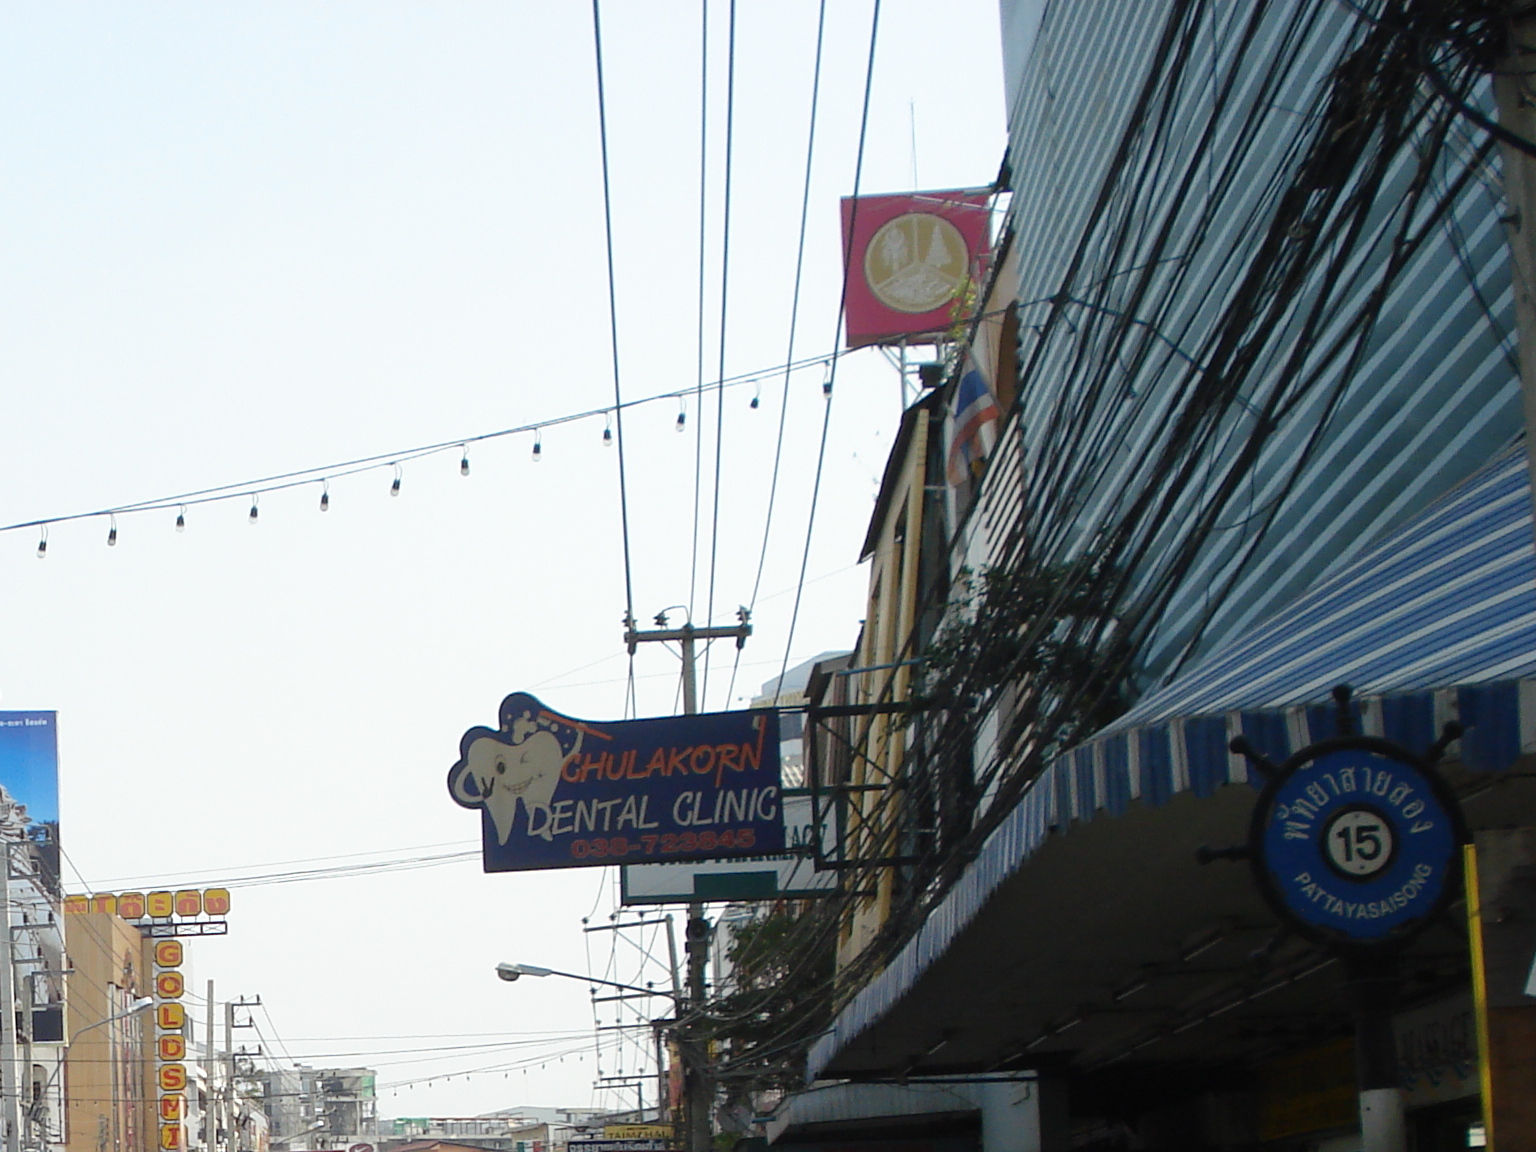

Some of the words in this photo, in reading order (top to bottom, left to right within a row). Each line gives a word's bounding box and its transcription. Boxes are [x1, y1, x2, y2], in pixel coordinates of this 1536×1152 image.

[562, 724, 767, 787] CHULAKORN
[526, 797, 659, 838] DENTAL
[672, 785, 777, 827] CLINIC
[1277, 766, 1434, 841] พัทยาสายสอง
[570, 828, 756, 860] 038-723845
[1336, 824, 1383, 862] 15
[1293, 862, 1434, 921] PATTAYASAISONG
